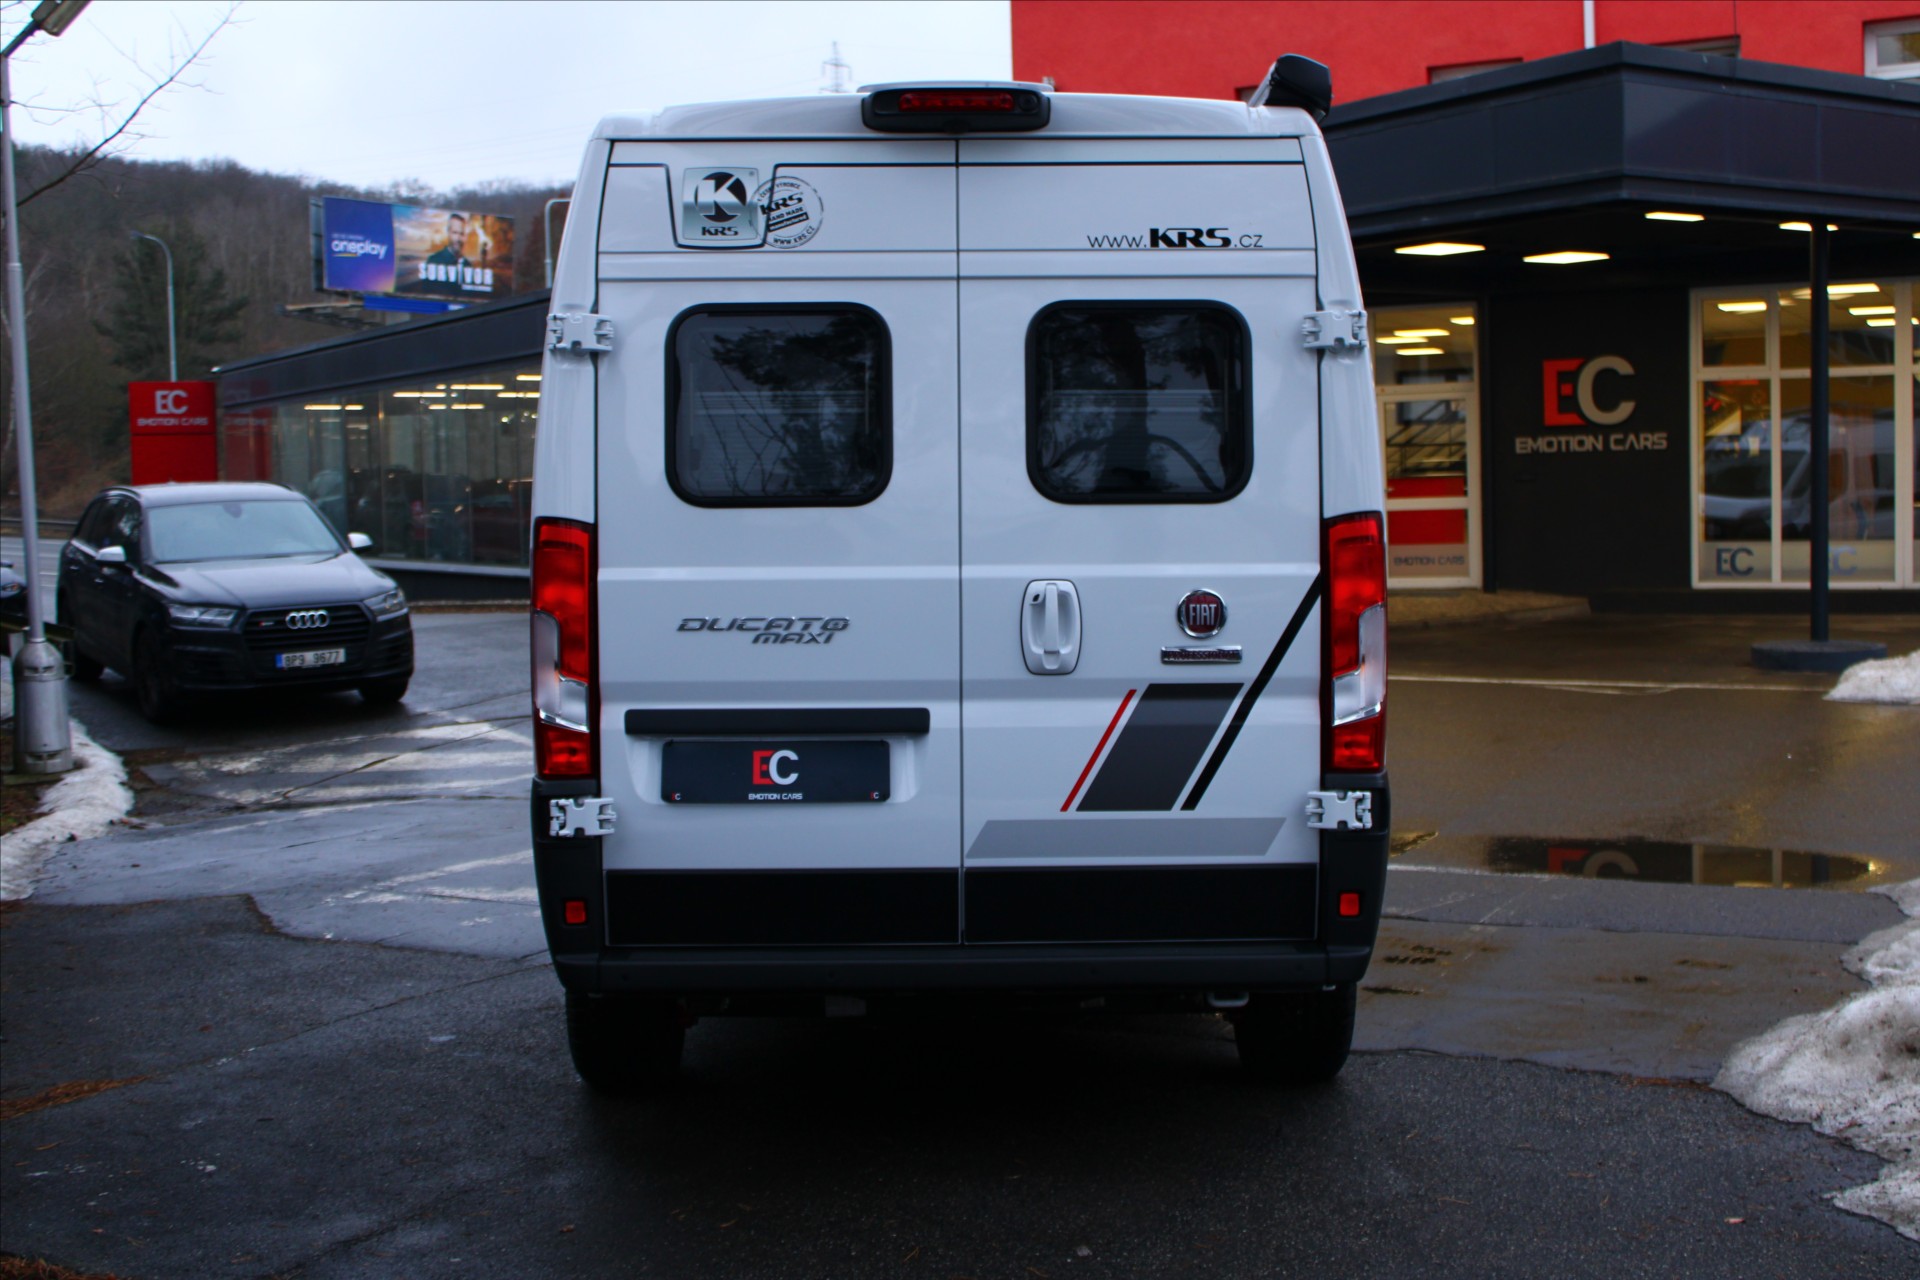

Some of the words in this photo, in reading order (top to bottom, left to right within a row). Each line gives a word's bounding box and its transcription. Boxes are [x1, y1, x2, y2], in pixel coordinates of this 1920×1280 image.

[760, 192, 803, 215] KRS
[786, 206, 803, 216] MADE
[701, 226, 739, 237] KRS
[1087, 227, 1264, 249] www.KRS.cz
[331, 239, 388, 260] oneplay
[418, 257, 494, 286] SURVIVOR
[154, 389, 189, 415] EC
[1542, 355, 1637, 427] EC
[1515, 435, 1603, 454] EMOTION
[1610, 432, 1668, 451] CARS
[1716, 547, 1755, 577] EC
[1829, 546, 1858, 577] C
[676, 616, 850, 632] DUCATO
[1189, 603, 1217, 626] FIAT
[752, 631, 836, 645] MAXI
[313, 651, 340, 665] 9677
[752, 749, 799, 786] EC
[748, 793, 781, 801] EMOTION
[782, 793, 803, 801] CARS
